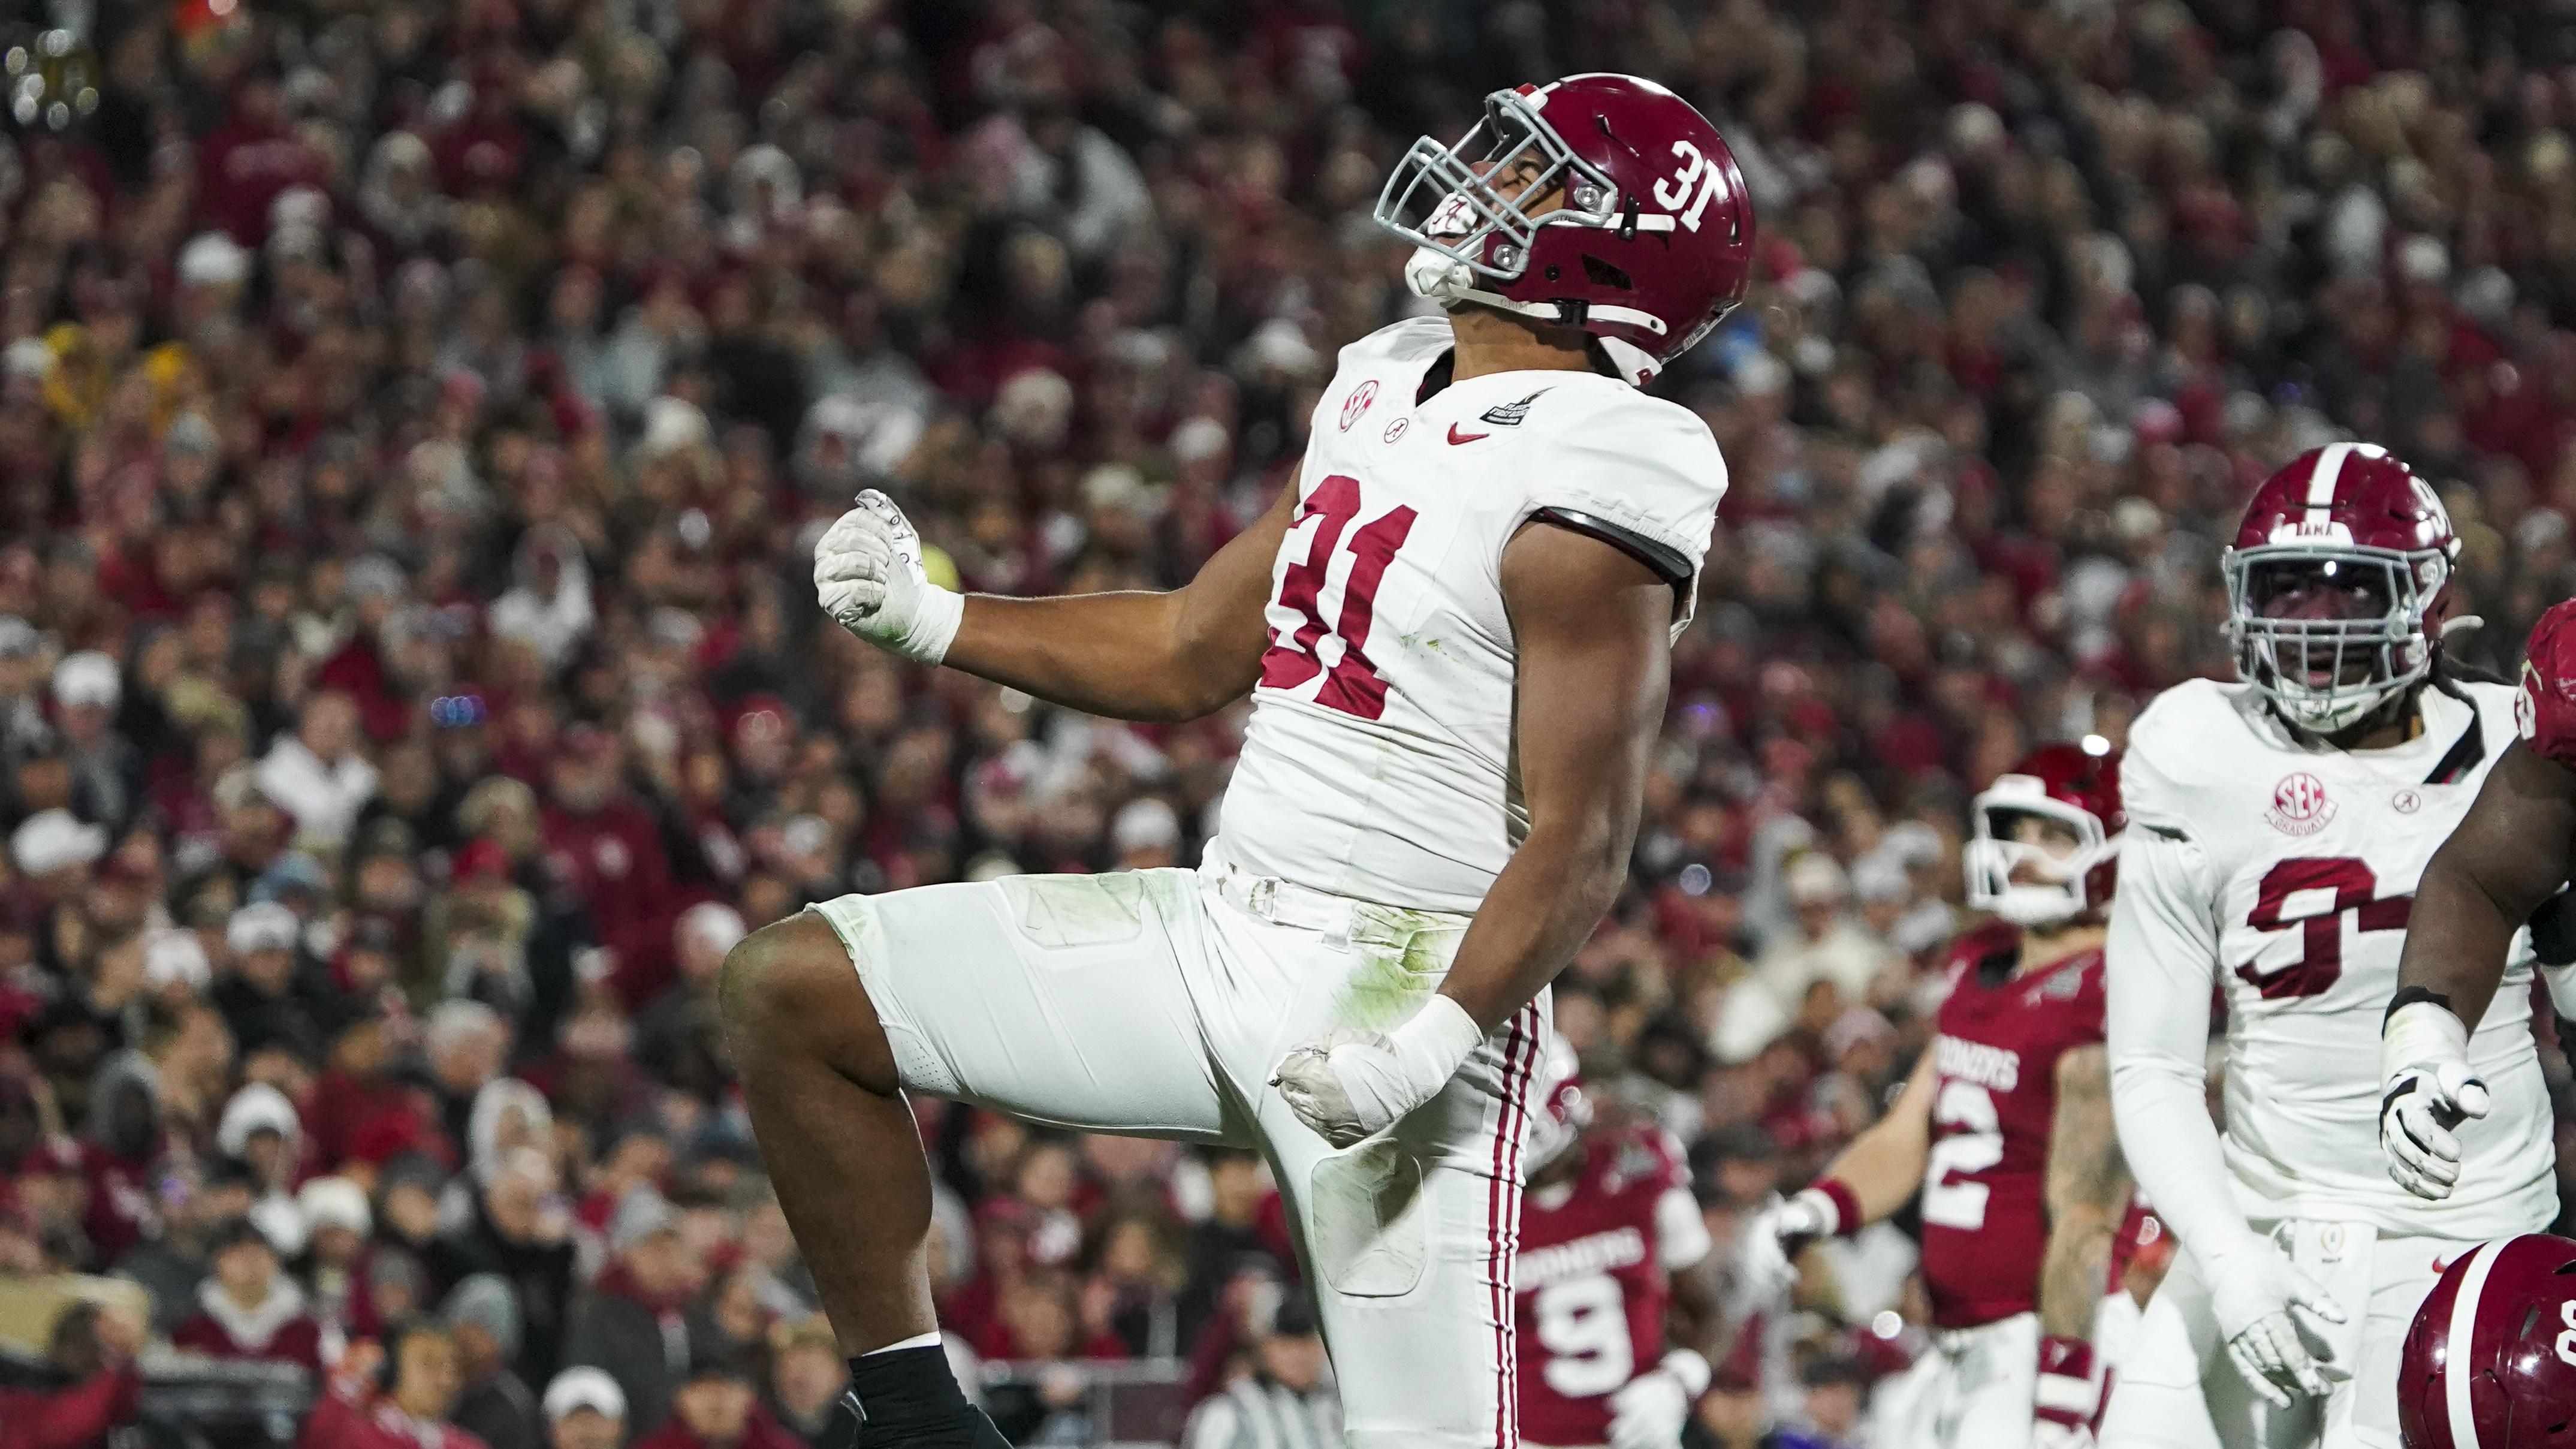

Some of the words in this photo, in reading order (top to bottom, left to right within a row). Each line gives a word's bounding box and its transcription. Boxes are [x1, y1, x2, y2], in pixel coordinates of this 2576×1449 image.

[1653, 140, 1719, 233] 31
[1260, 475, 1418, 721] 31
[2275, 773, 2324, 819] SEC
[1923, 1081, 2004, 1230] 2
[1534, 1274, 1635, 1397] 9
